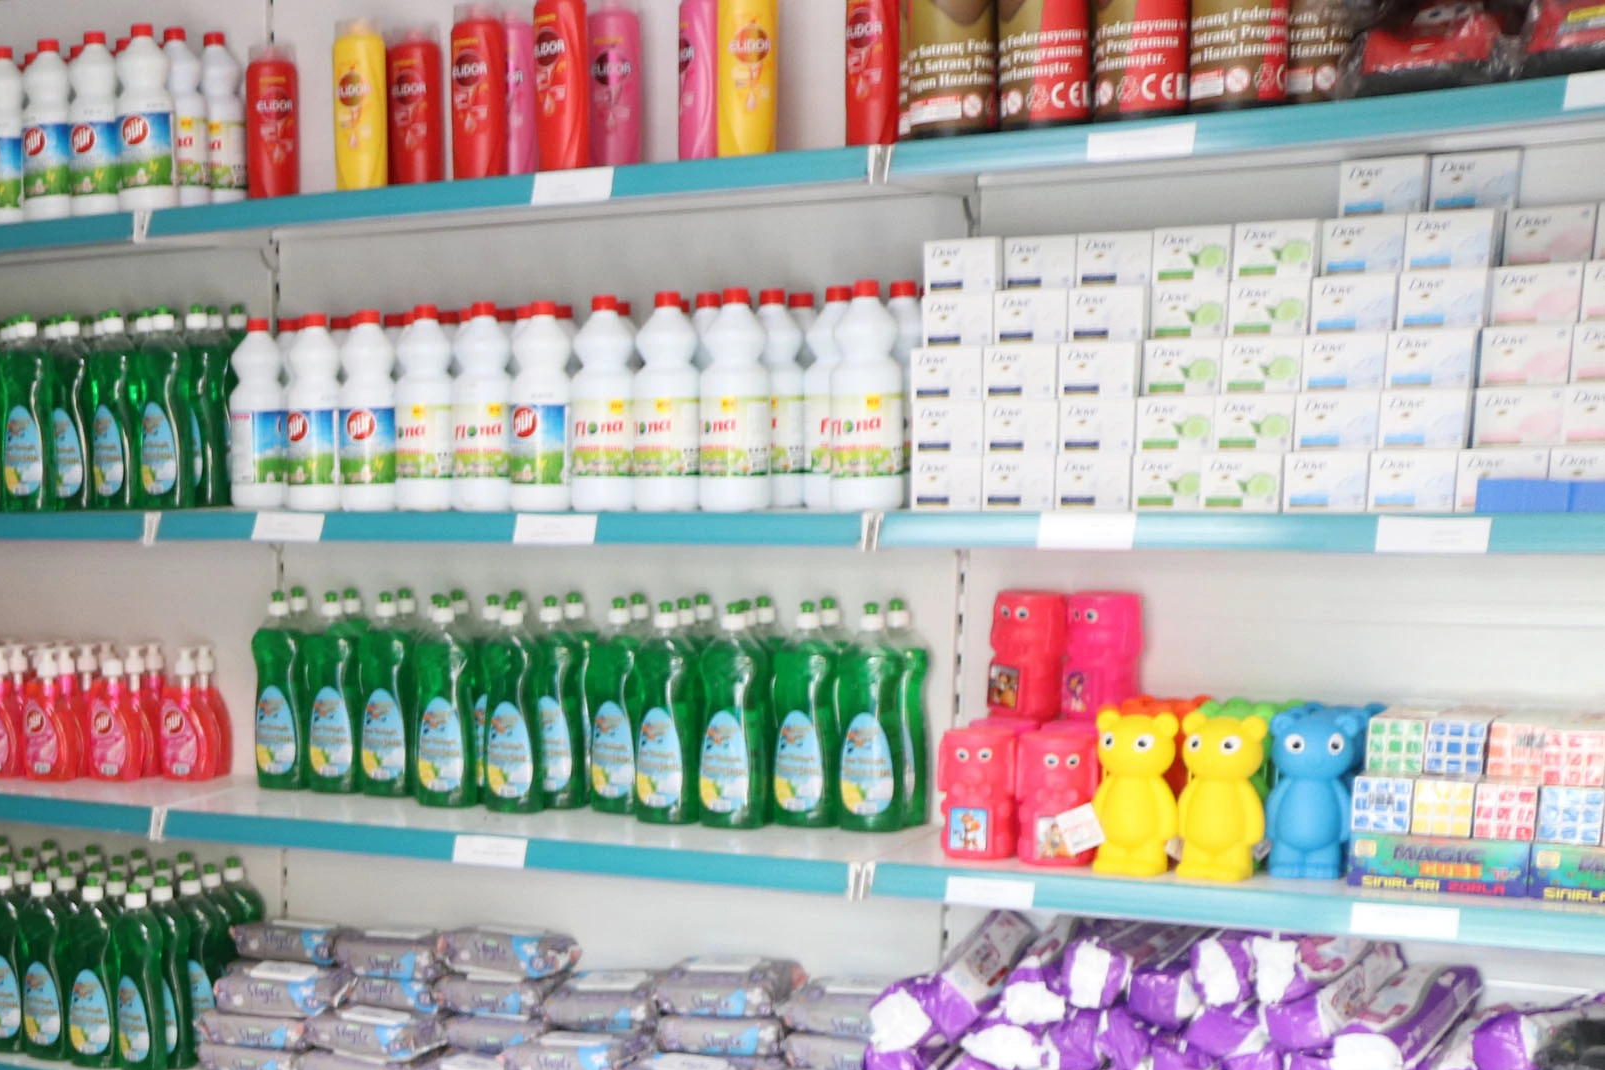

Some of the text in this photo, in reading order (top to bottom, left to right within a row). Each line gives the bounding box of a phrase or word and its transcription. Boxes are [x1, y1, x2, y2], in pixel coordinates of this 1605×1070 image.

[1102, 19, 1177, 38] Federasyonu
[1008, 29, 1081, 47] Federasyonu
[1106, 35, 1178, 52] Programına
[1393, 845, 1487, 863] MAGIC
[1362, 875, 1505, 896] SINIRLARI ZORLA
